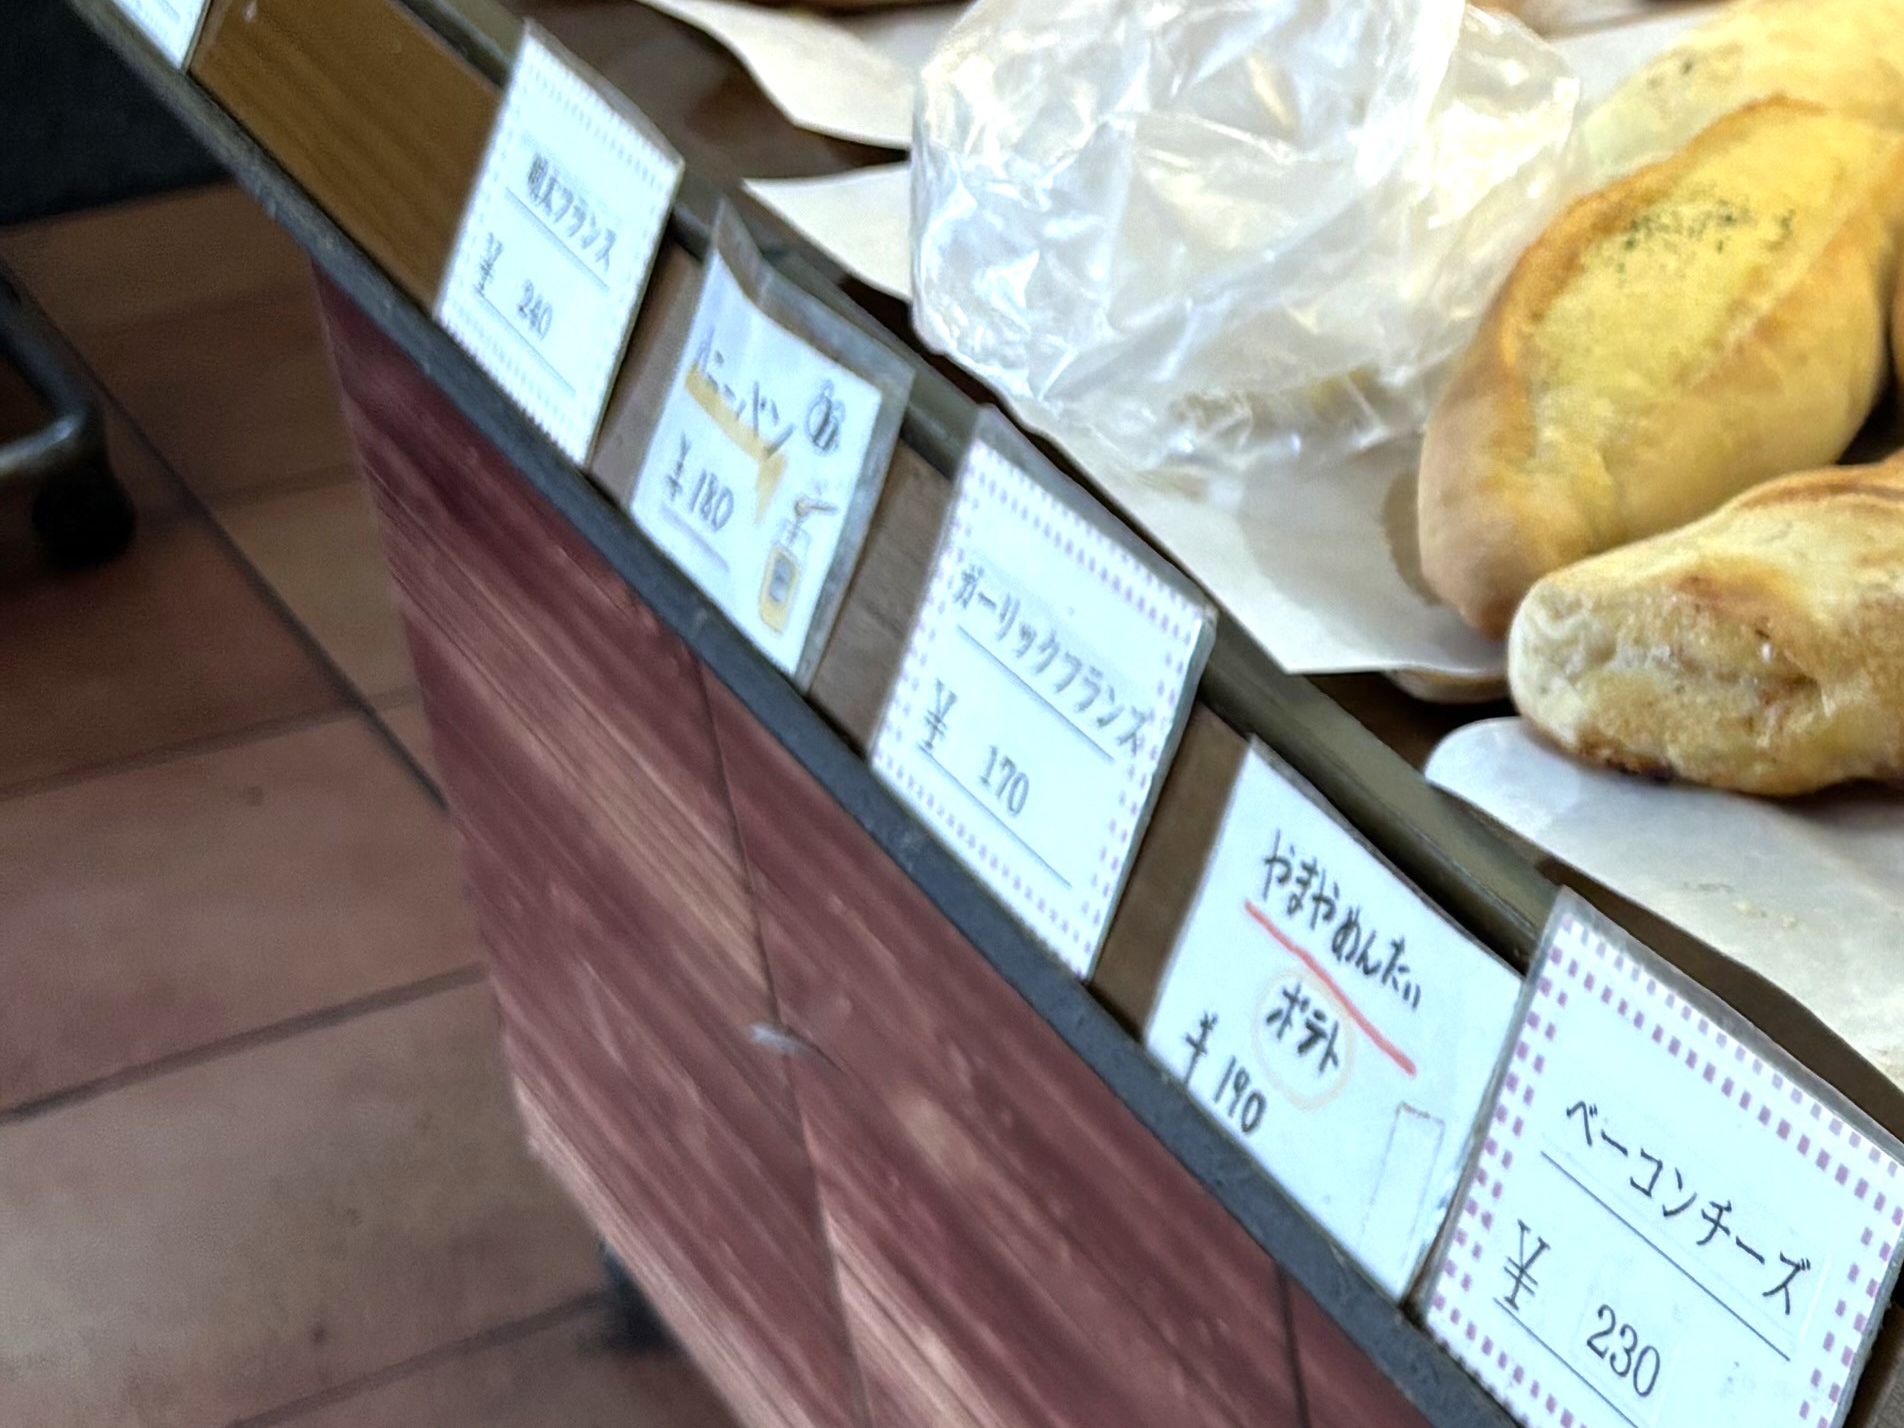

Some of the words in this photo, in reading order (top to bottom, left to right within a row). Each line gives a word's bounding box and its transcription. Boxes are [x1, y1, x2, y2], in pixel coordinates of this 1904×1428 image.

[516, 278, 554, 341] 240
[922, 677, 958, 752] ¥
[979, 744, 1030, 818] 170
[951, 562, 1154, 758] ガーリックフランス
[1263, 829, 1421, 1012] やまやめんたい
[1265, 982, 1341, 1074] ポテト
[1565, 1099, 1813, 1316] ベーコンチーズ
[1500, 1218, 1551, 1313] ¥
[1585, 1304, 1662, 1398] 230
